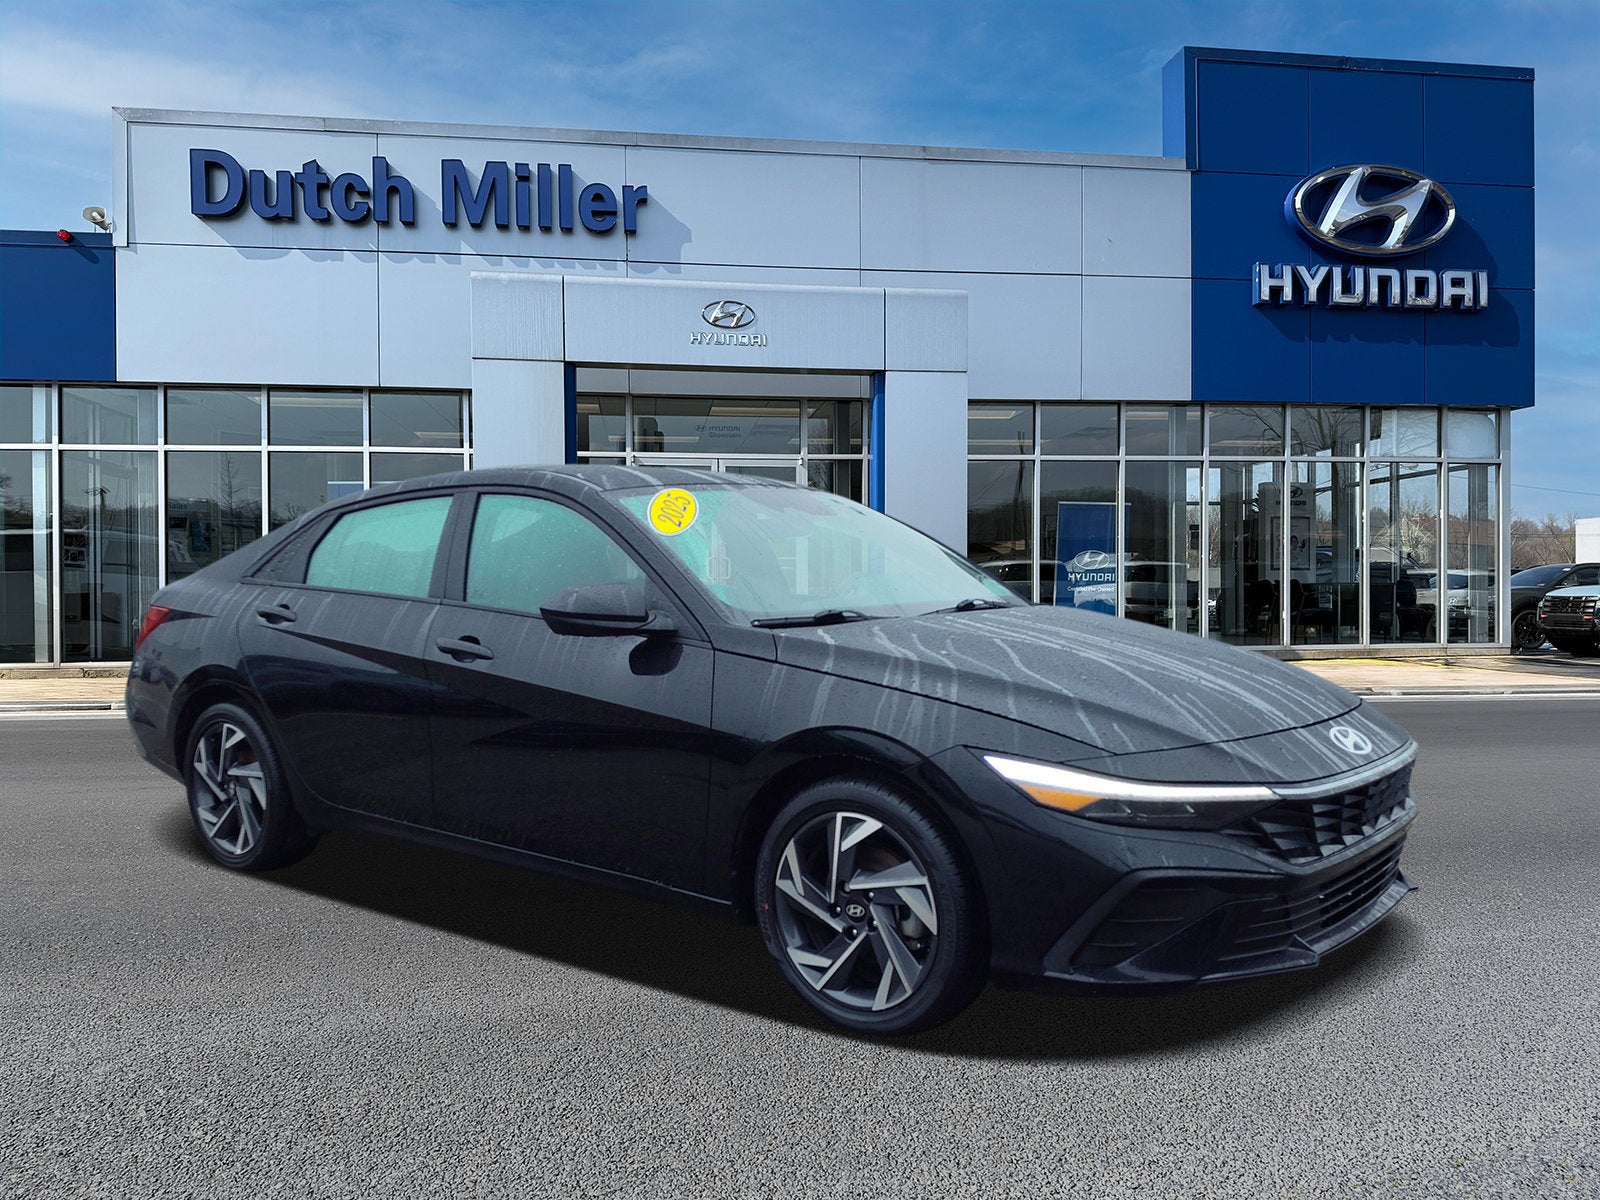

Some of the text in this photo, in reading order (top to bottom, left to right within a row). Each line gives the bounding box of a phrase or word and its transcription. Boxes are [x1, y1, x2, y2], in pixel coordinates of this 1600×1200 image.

[188, 147, 648, 234] Dutch Miller
[1253, 262, 1489, 310] HYUNDAI
[690, 332, 767, 346] HYUNDAI
[657, 493, 691, 528] 2025
[1067, 572, 1115, 582] HYUNDAI
